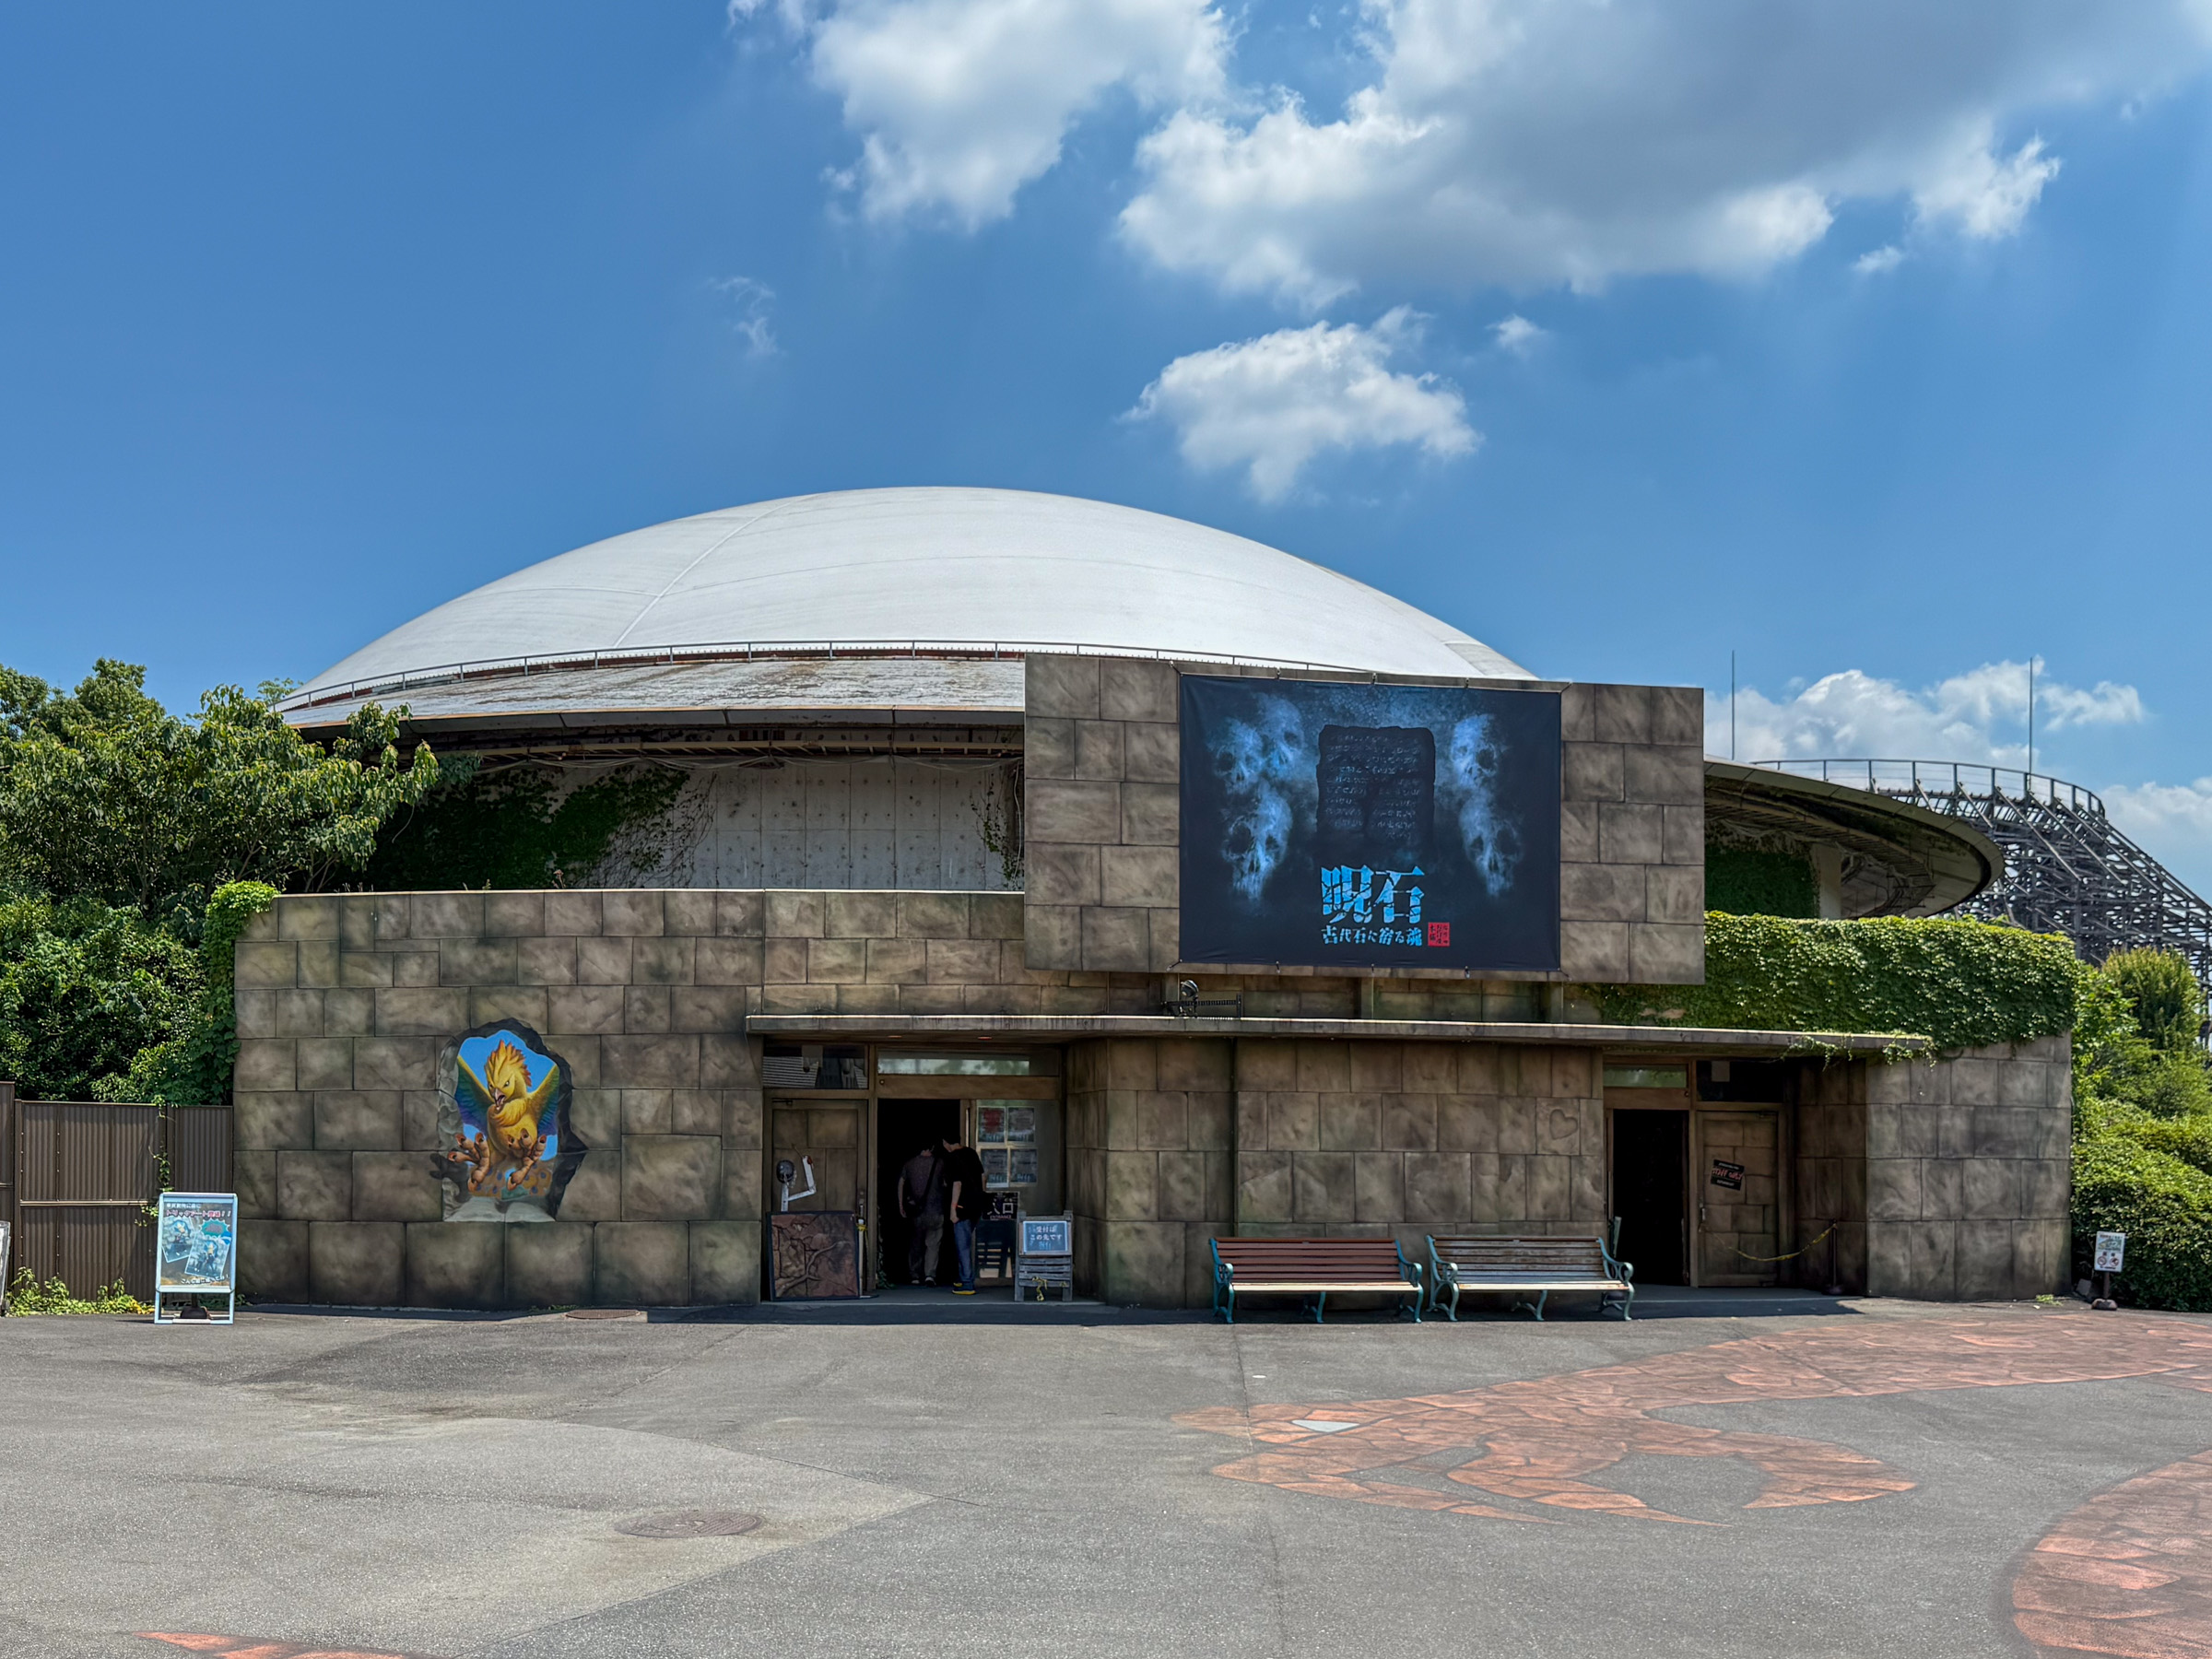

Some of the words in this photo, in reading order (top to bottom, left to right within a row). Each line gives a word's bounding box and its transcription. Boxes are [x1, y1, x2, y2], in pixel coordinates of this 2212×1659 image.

[1321, 865, 1425, 924] 呪石
[1321, 924, 1422, 947] 古代石に宿る魂
[1030, 1233, 1063, 1241] この先です
